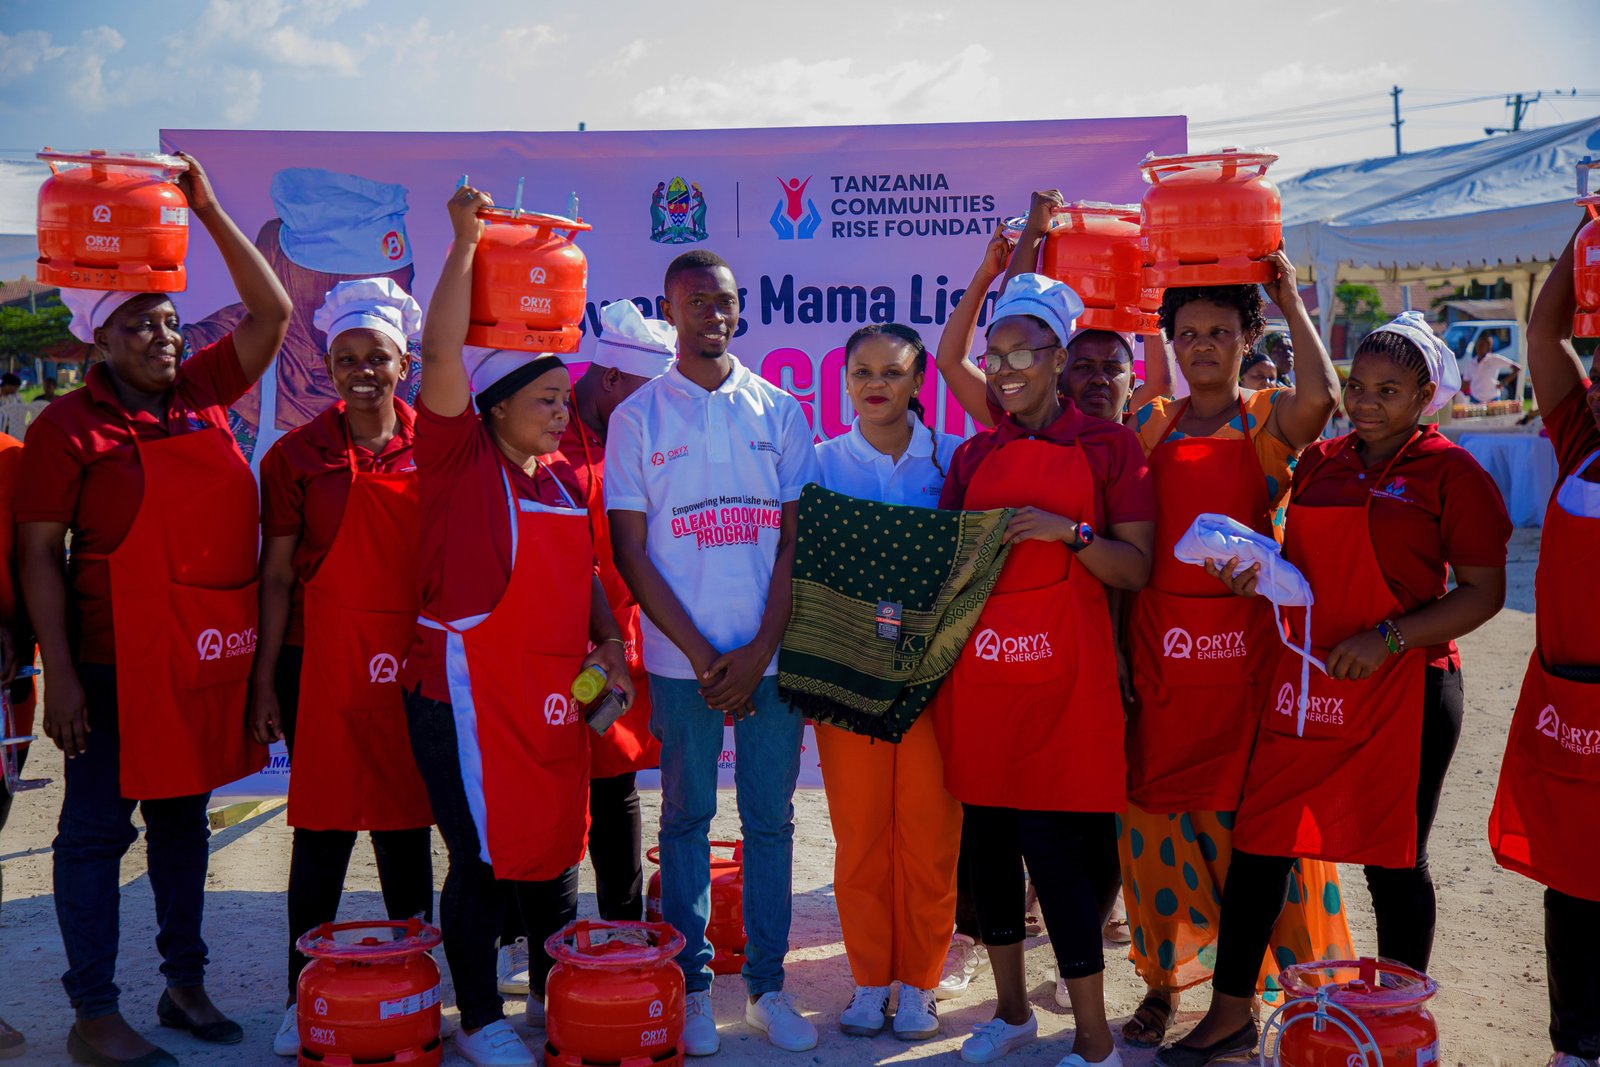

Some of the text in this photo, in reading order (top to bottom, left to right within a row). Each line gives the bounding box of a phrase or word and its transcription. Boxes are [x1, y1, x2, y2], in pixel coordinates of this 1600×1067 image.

[831, 173, 949, 193] TANZANIA
[831, 195, 995, 216] COMMUNITIES
[832, 220, 879, 238] RISE
[85, 235, 120, 247] ORYX
[520, 296, 551, 308] ORYX
[760, 273, 896, 325] Mama
[672, 498, 718, 516] Empowering
[719, 496, 742, 505] Mama
[762, 498, 780, 507] with
[671, 506, 782, 538] CLEAN COOKING
[696, 524, 759, 550] PROGRAM
[1002, 632, 1050, 654] ORYX
[1196, 631, 1245, 651] ORYX
[1004, 648, 1053, 662] ENERGIES
[1197, 647, 1247, 660] ENERGIES
[310, 1026, 335, 1040] ORYX
[641, 1027, 667, 1041] ORYX
